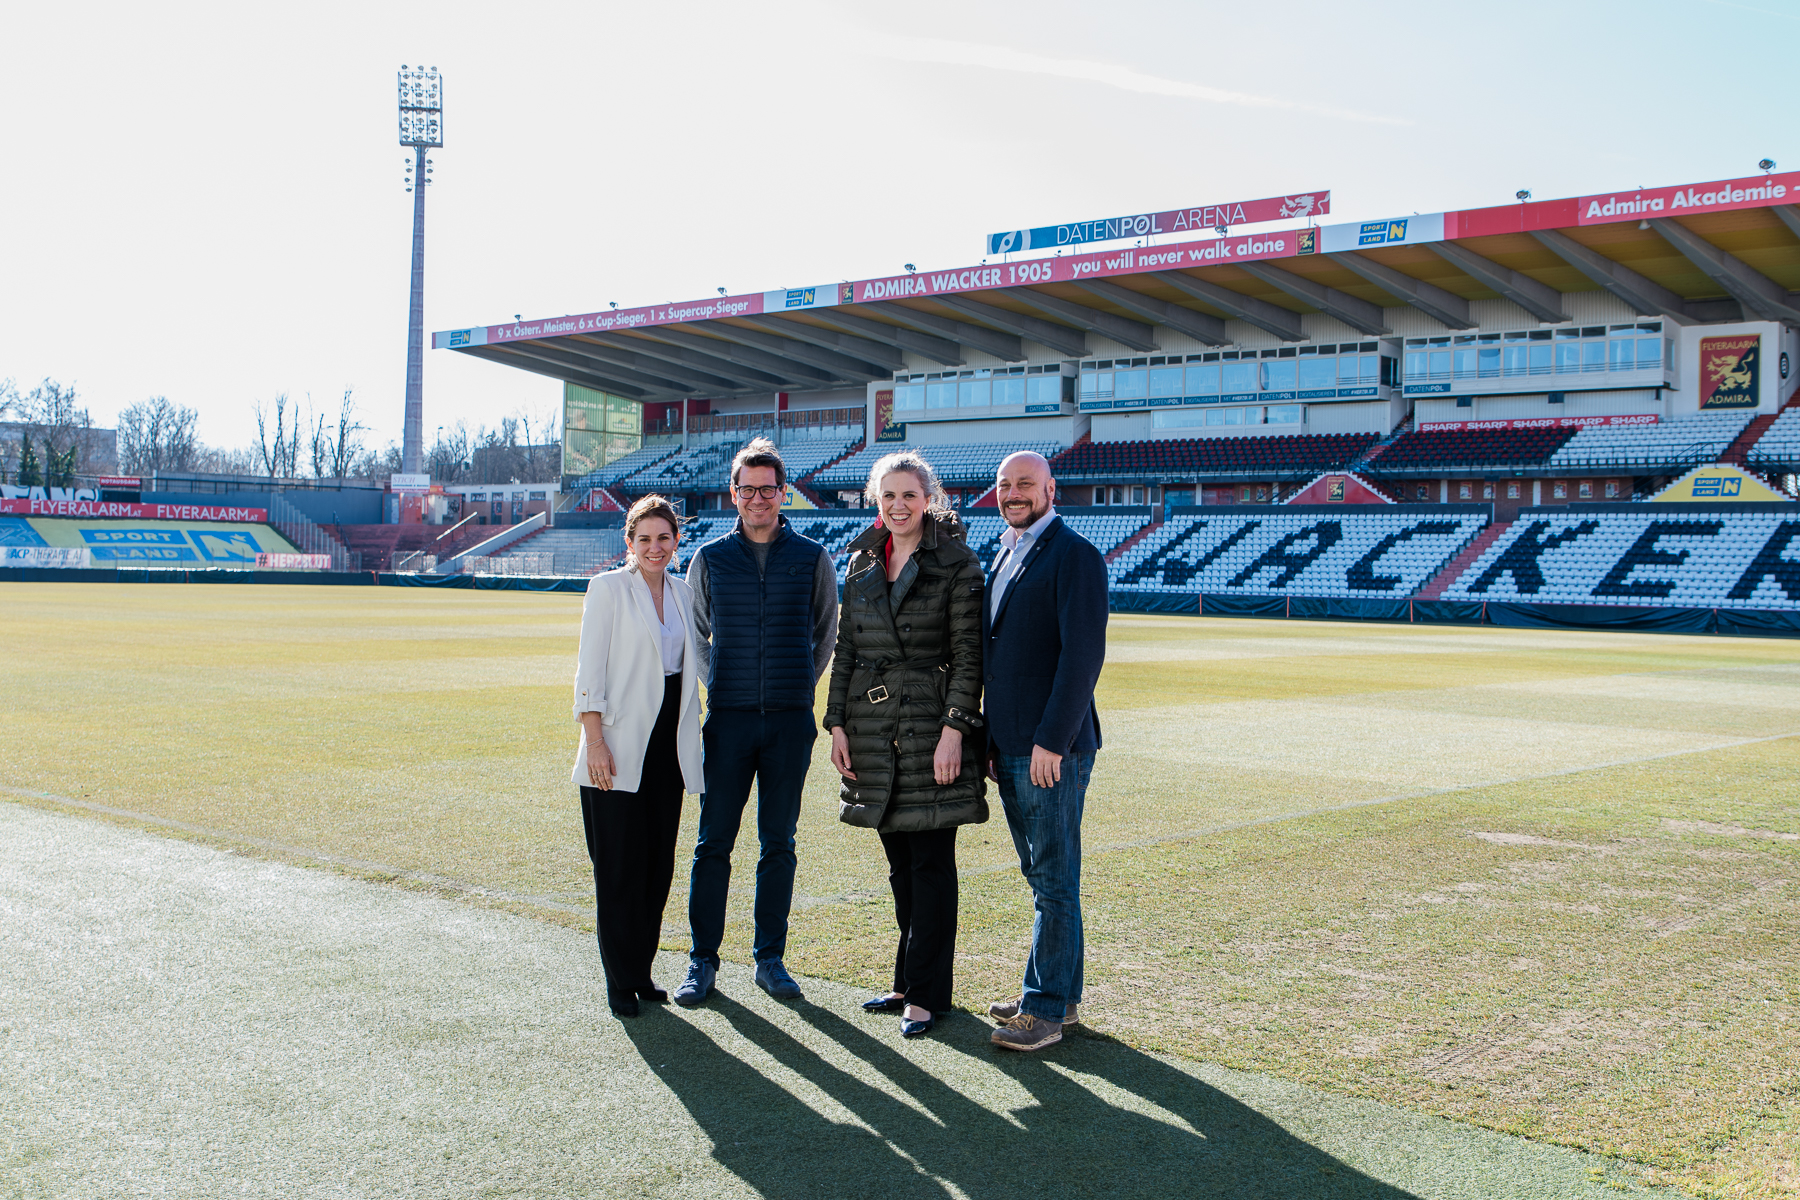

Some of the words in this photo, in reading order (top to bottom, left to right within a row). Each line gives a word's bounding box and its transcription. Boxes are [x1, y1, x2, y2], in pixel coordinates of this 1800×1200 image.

[1586, 196, 1665, 219] Admira
[1671, 181, 1787, 209] Akademie
[1057, 213, 1162, 245] DATENPOL
[1173, 203, 1247, 231] ARENA
[1363, 224, 1384, 232] SPORT
[1389, 222, 1405, 239] N
[1363, 235, 1382, 243] LAND
[1072, 258, 1101, 278] you
[1105, 251, 1134, 270] will
[1138, 249, 1184, 267] never
[1188, 241, 1232, 261] walk
[1236, 237, 1285, 256] alone
[863, 276, 927, 300] ADMIRA
[932, 267, 1002, 292] WACKER
[1008, 261, 1052, 284] 1905
[804, 290, 814, 303] N
[498, 327, 504, 339] 9
[506, 330, 512, 338] x
[513, 322, 542, 338] Österr.
[543, 318, 577, 334] Meister,
[579, 318, 585, 329] 6
[588, 321, 594, 329] x
[596, 311, 648, 328] Cup-Sieger,
[658, 312, 666, 320] x
[668, 300, 749, 322] Supercup-Sieger
[1702, 340, 1759, 351] FLYERALARM
[1409, 385, 1444, 393] DATENPOL
[1151, 398, 1180, 406] DATENPOL
[1262, 392, 1292, 400] DATENPOL
[1706, 394, 1753, 405] ADMIRA
[1422, 422, 1462, 432] SHARP
[1466, 420, 1507, 430] SHARP
[1512, 419, 1555, 429] SHARP
[1560, 418, 1604, 427] SHARP
[1610, 416, 1656, 425] SHARP
[1723, 478, 1740, 494] N
[94, 531, 172, 542] SPORT
[112, 549, 180, 559] LAND
